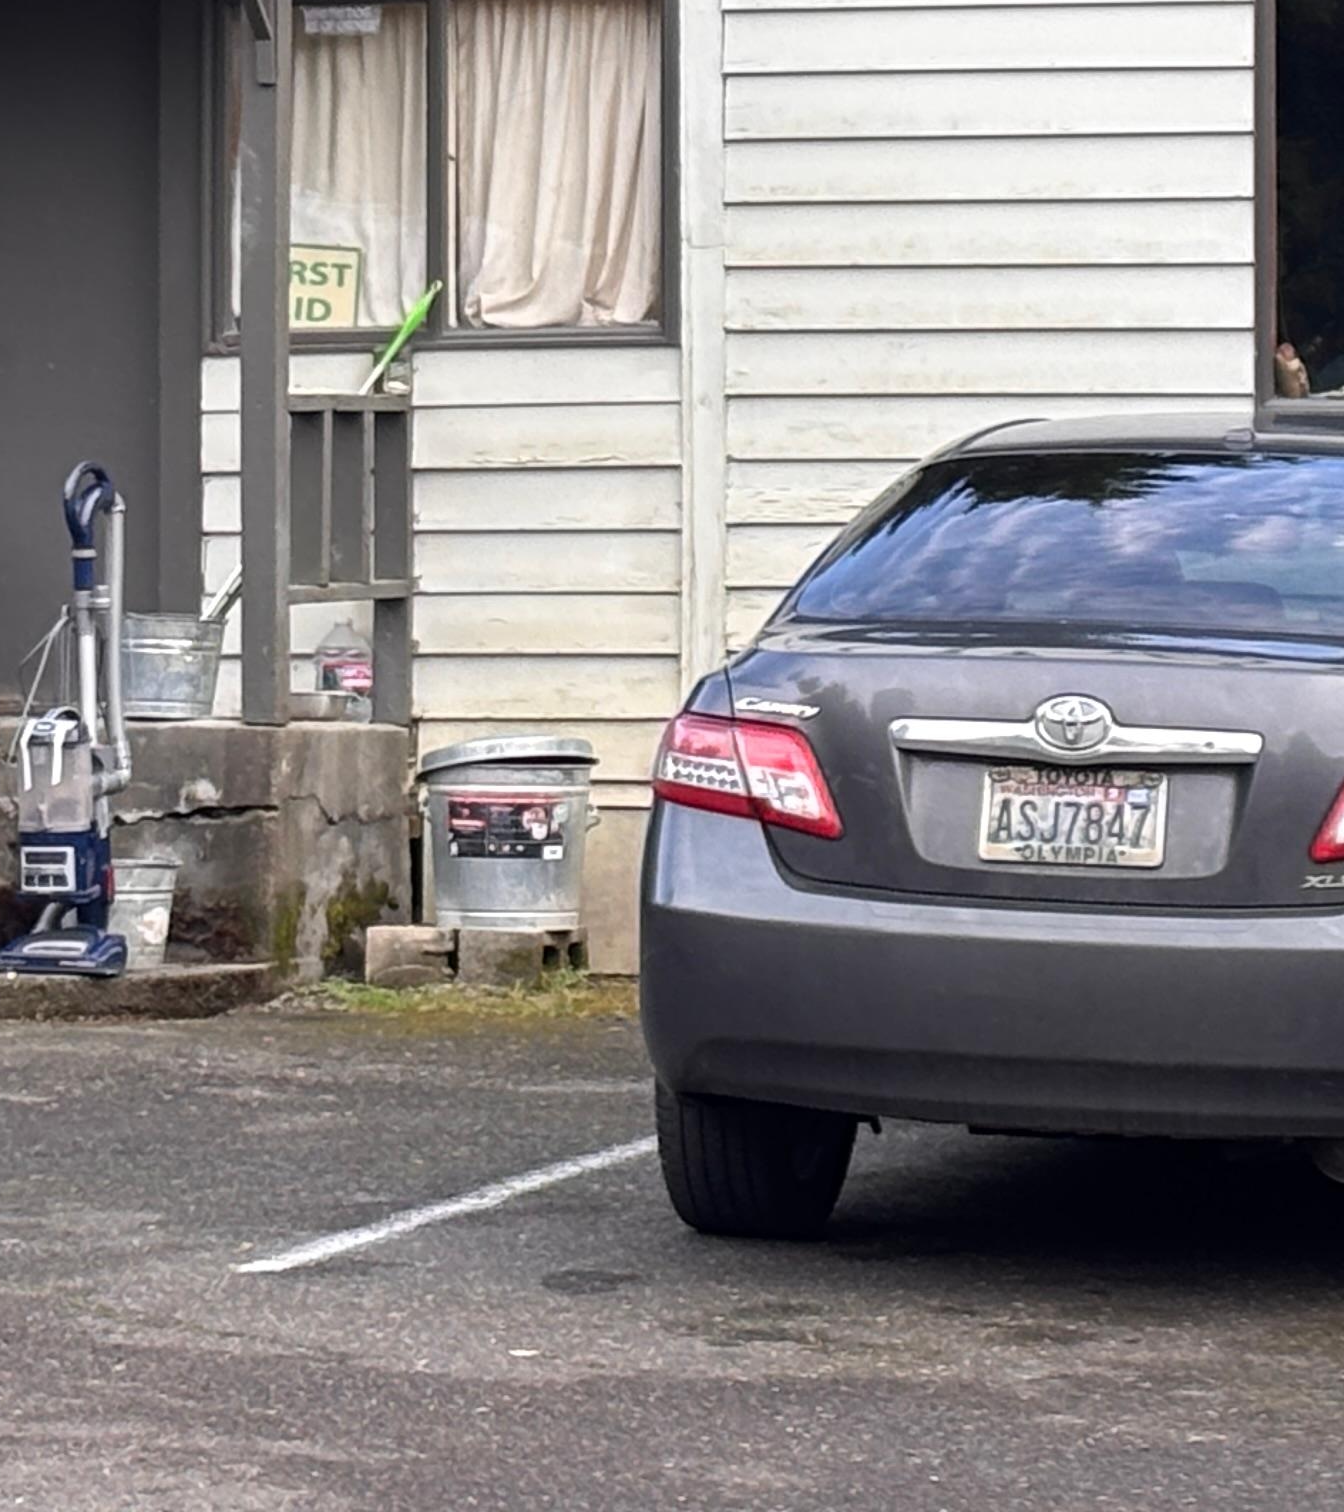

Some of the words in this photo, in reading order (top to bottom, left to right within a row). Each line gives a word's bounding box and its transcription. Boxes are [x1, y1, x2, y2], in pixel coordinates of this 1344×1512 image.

[288, 260, 353, 288] RST
[294, 296, 332, 322] ID
[1036, 767, 1114, 786] TOYOTA
[995, 798, 1151, 848] ASJ7847
[1020, 844, 1118, 863] OLYMPIA
